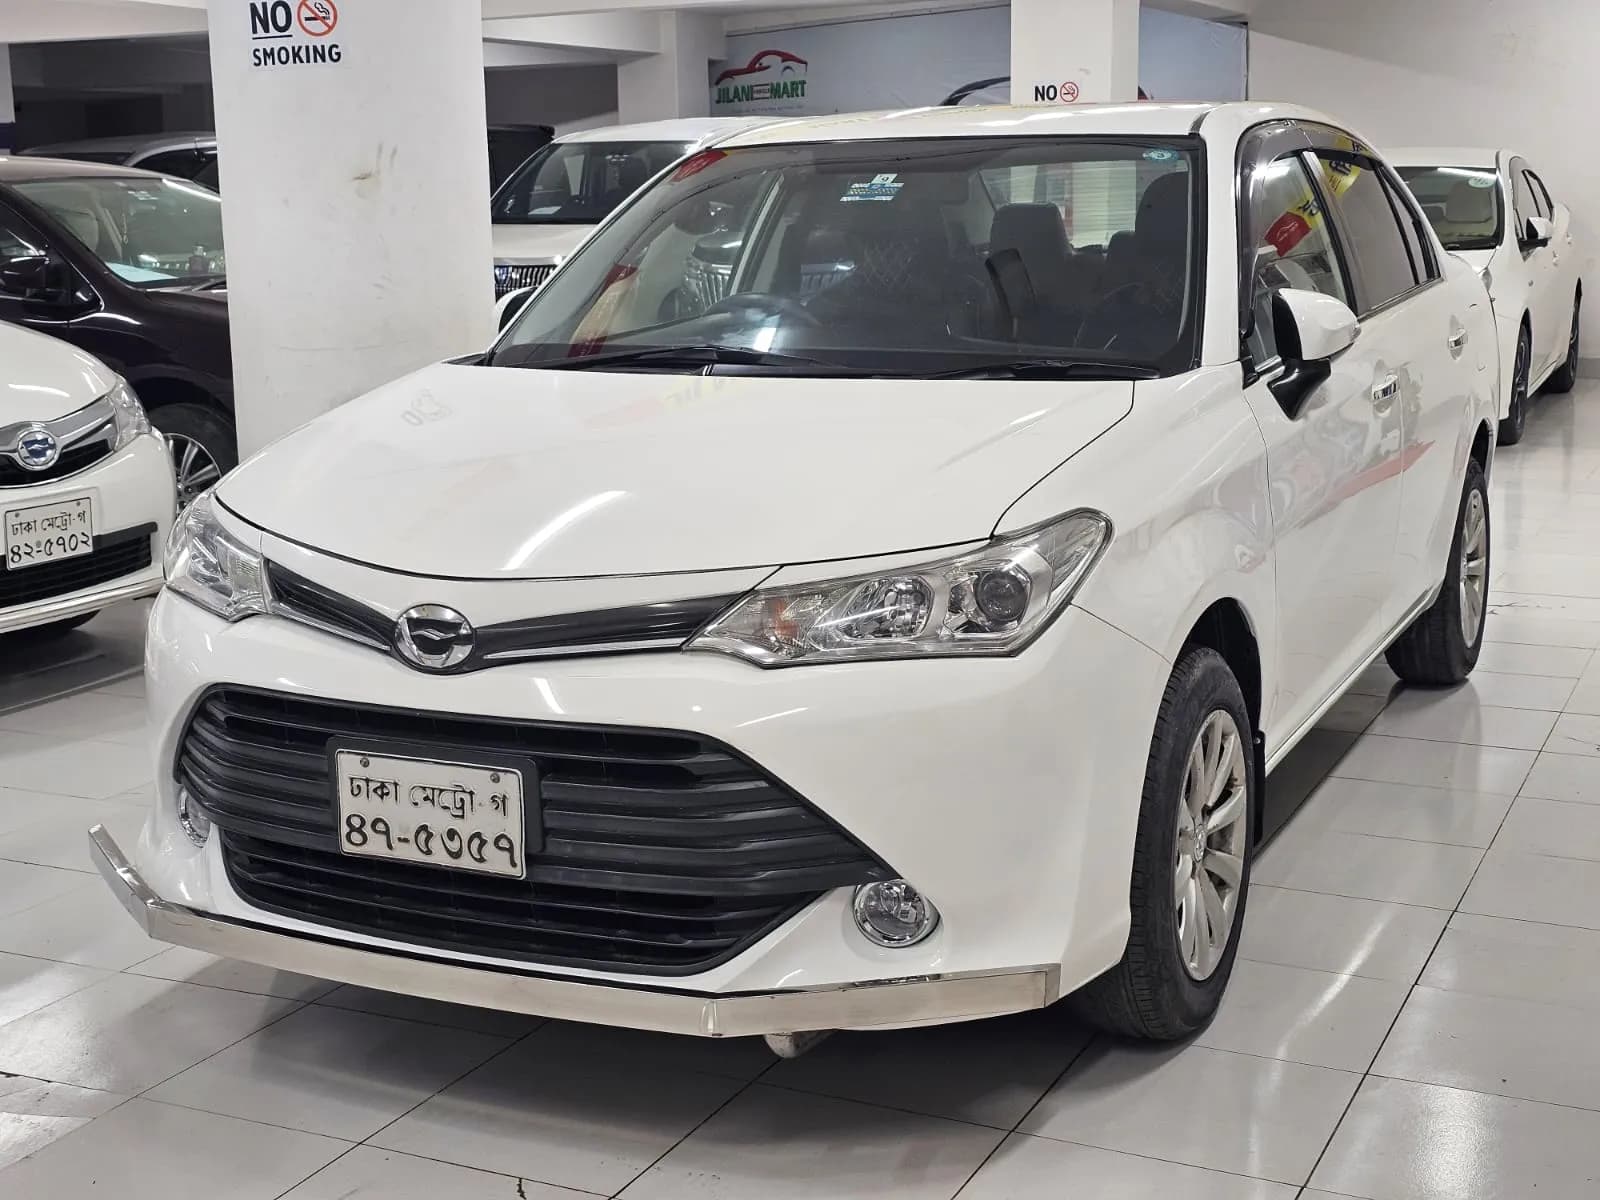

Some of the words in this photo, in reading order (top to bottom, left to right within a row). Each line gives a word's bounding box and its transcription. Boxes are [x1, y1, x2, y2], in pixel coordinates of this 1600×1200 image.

[250, 1, 292, 34] NO
[253, 44, 341, 67] SMOKING
[715, 84, 753, 104] JILANI
[769, 80, 806, 99] MART
[1034, 84, 1058, 101] NO
[11, 520, 37, 535] ঢাকা
[10, 532, 90, 563] ৪২-৫৭০২
[349, 776, 399, 802] ঢাকা
[345, 813, 517, 868] ৪৭-৫৩৫৭
